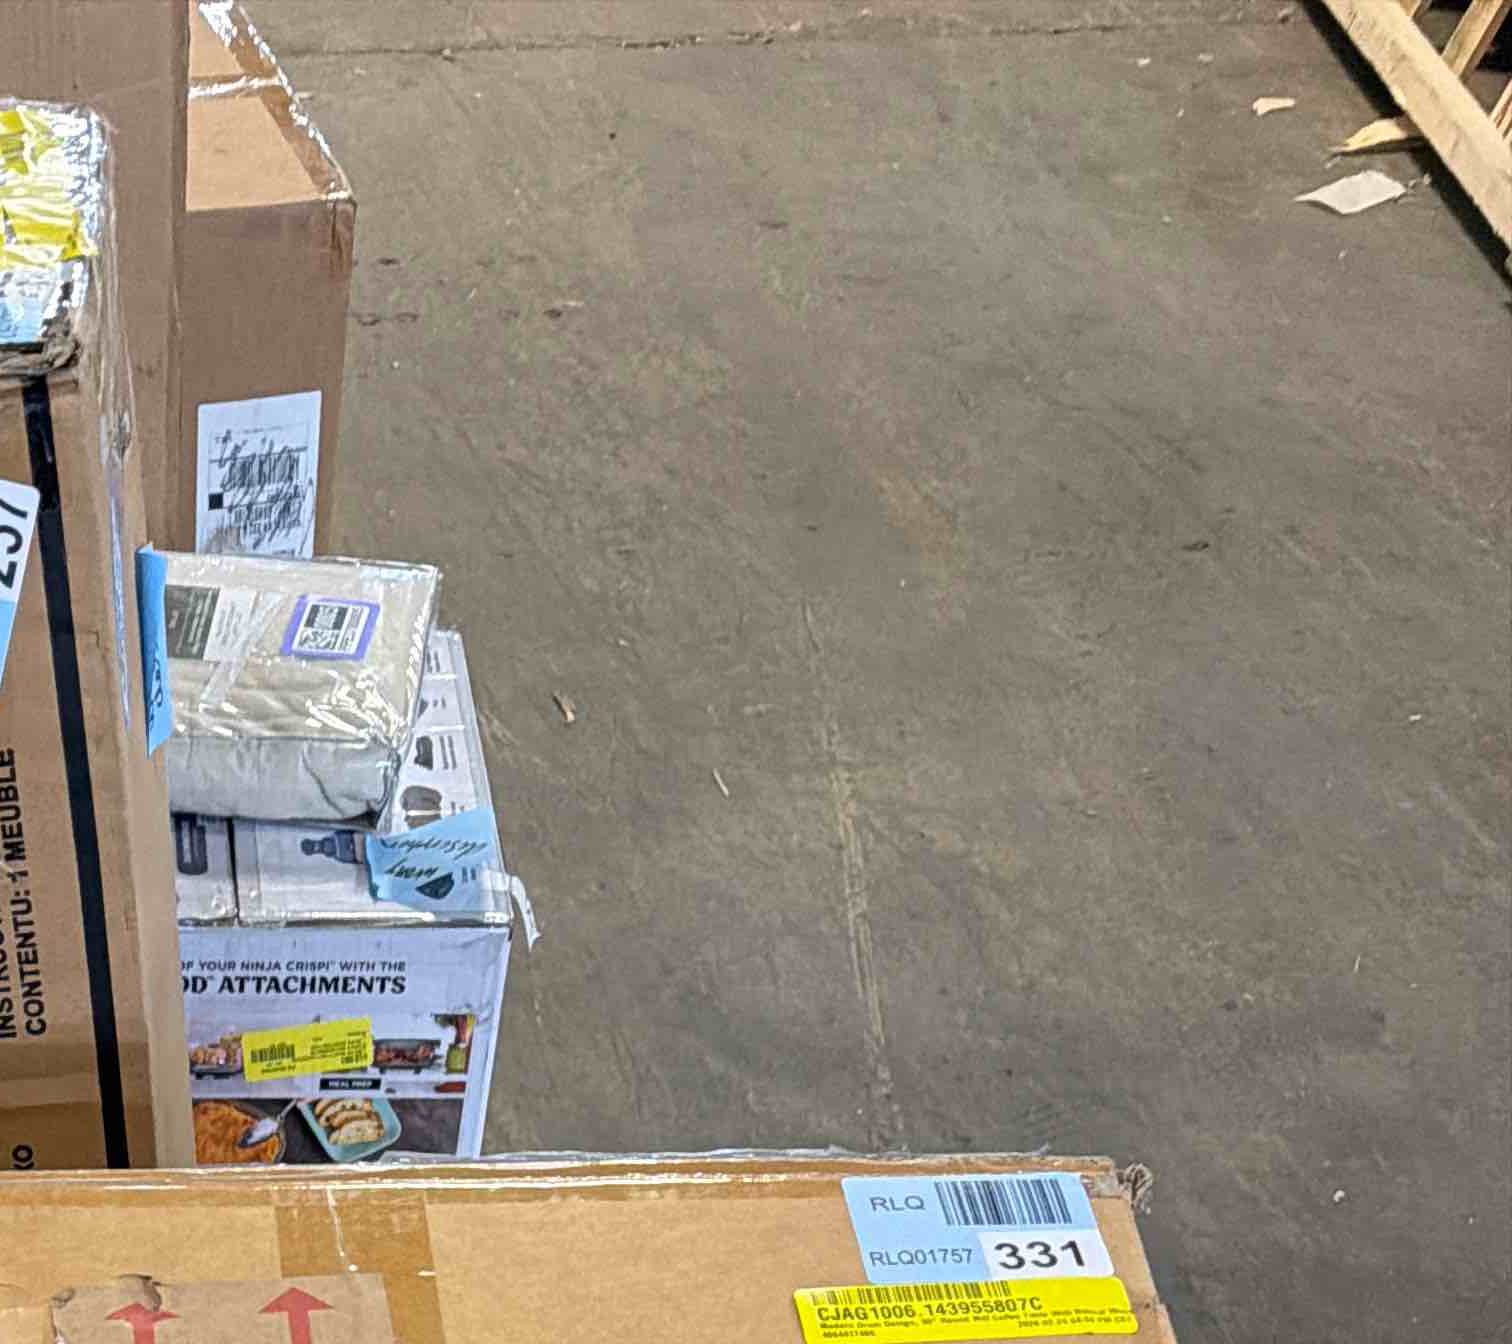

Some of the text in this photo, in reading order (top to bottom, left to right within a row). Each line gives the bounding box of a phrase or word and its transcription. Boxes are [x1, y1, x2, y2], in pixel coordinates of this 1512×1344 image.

[13, 886, 47, 1037] CONTENTU:
[199, 960, 236, 972] YOUR
[240, 960, 281, 972] NINJA
[339, 960, 376, 972] WITH
[380, 960, 406, 972] THE
[217, 975, 406, 994] ATTACHMENTS
[870, 1195, 925, 1212] RLQ
[870, 1240, 1086, 1270] RLQ01757 331
